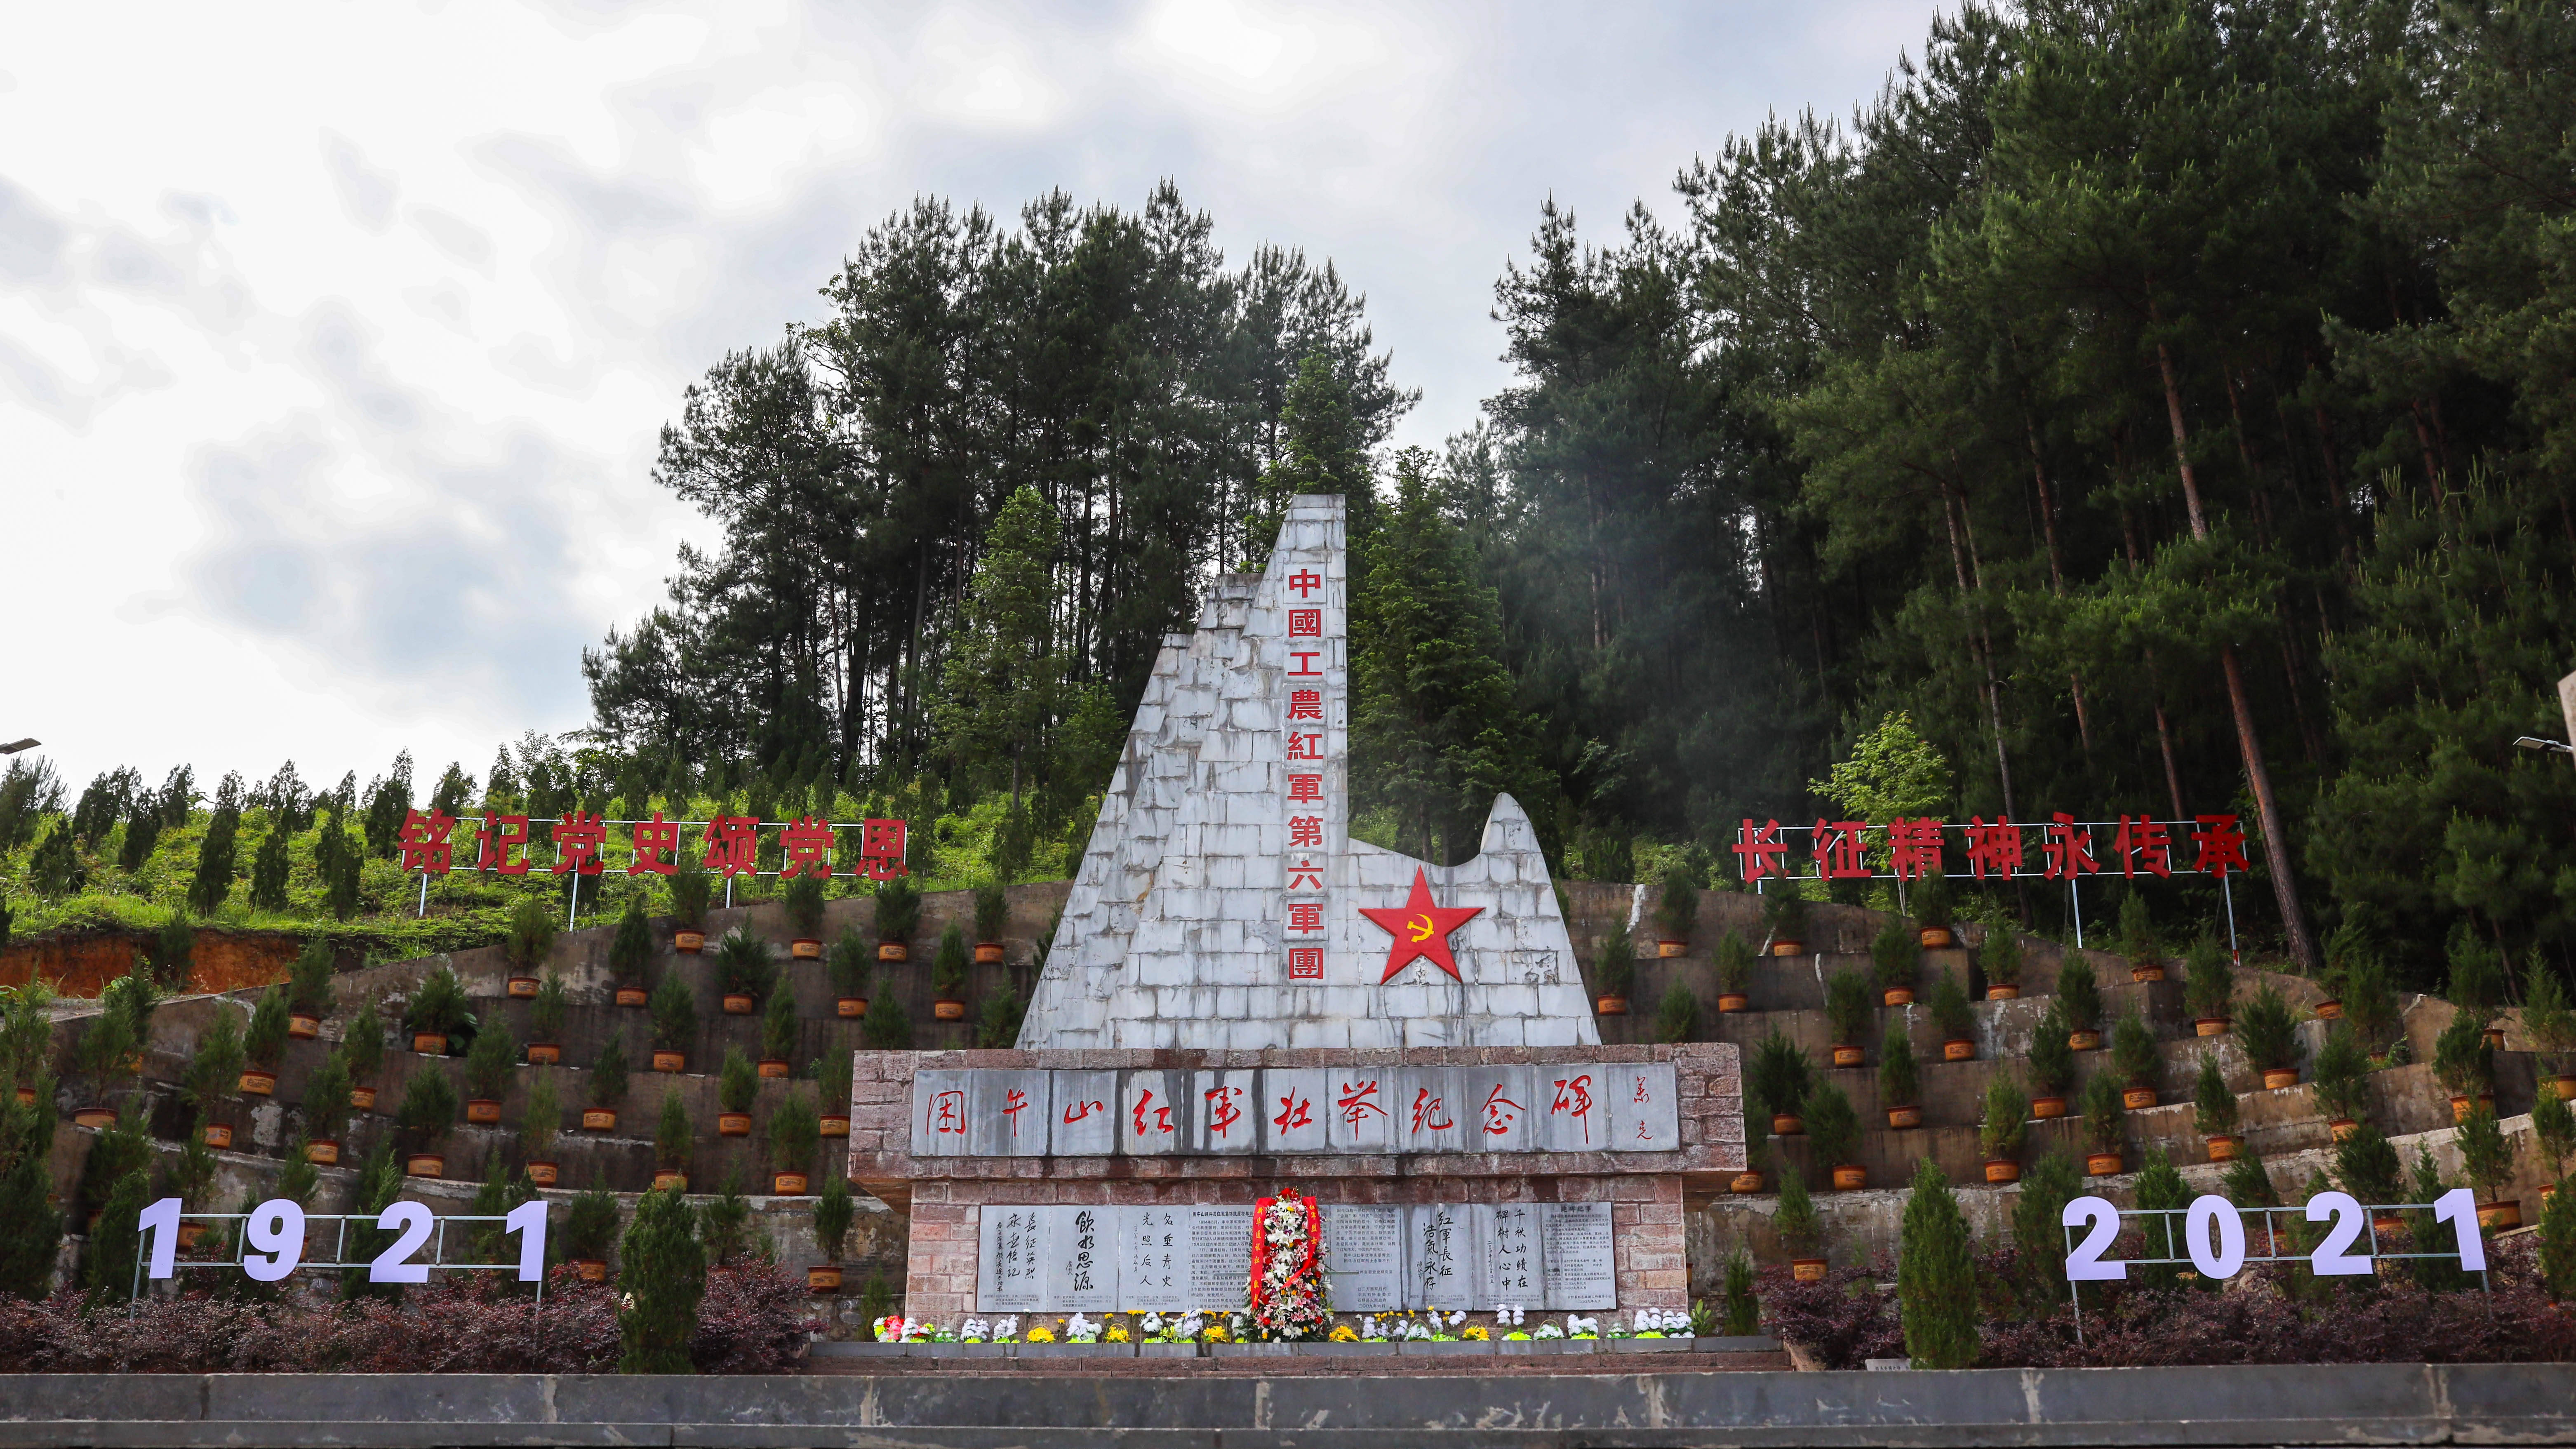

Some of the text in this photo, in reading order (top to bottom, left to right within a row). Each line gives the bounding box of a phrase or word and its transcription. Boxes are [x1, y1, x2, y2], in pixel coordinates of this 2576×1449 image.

[1287, 569, 1324, 979] 中國工農紅軍第六軍團
[398, 808, 908, 881] 铭记党史颂党恩
[1732, 811, 2250, 884] 长征精神永传承
[138, 1198, 548, 1283] 1921
[1140, 1212, 1153, 1285] 光照后人
[1162, 1213, 1173, 1287] 名垂青史
[1308, 1204, 1318, 1245] 红军烈士
[2063, 1188, 2486, 1281] 2021
